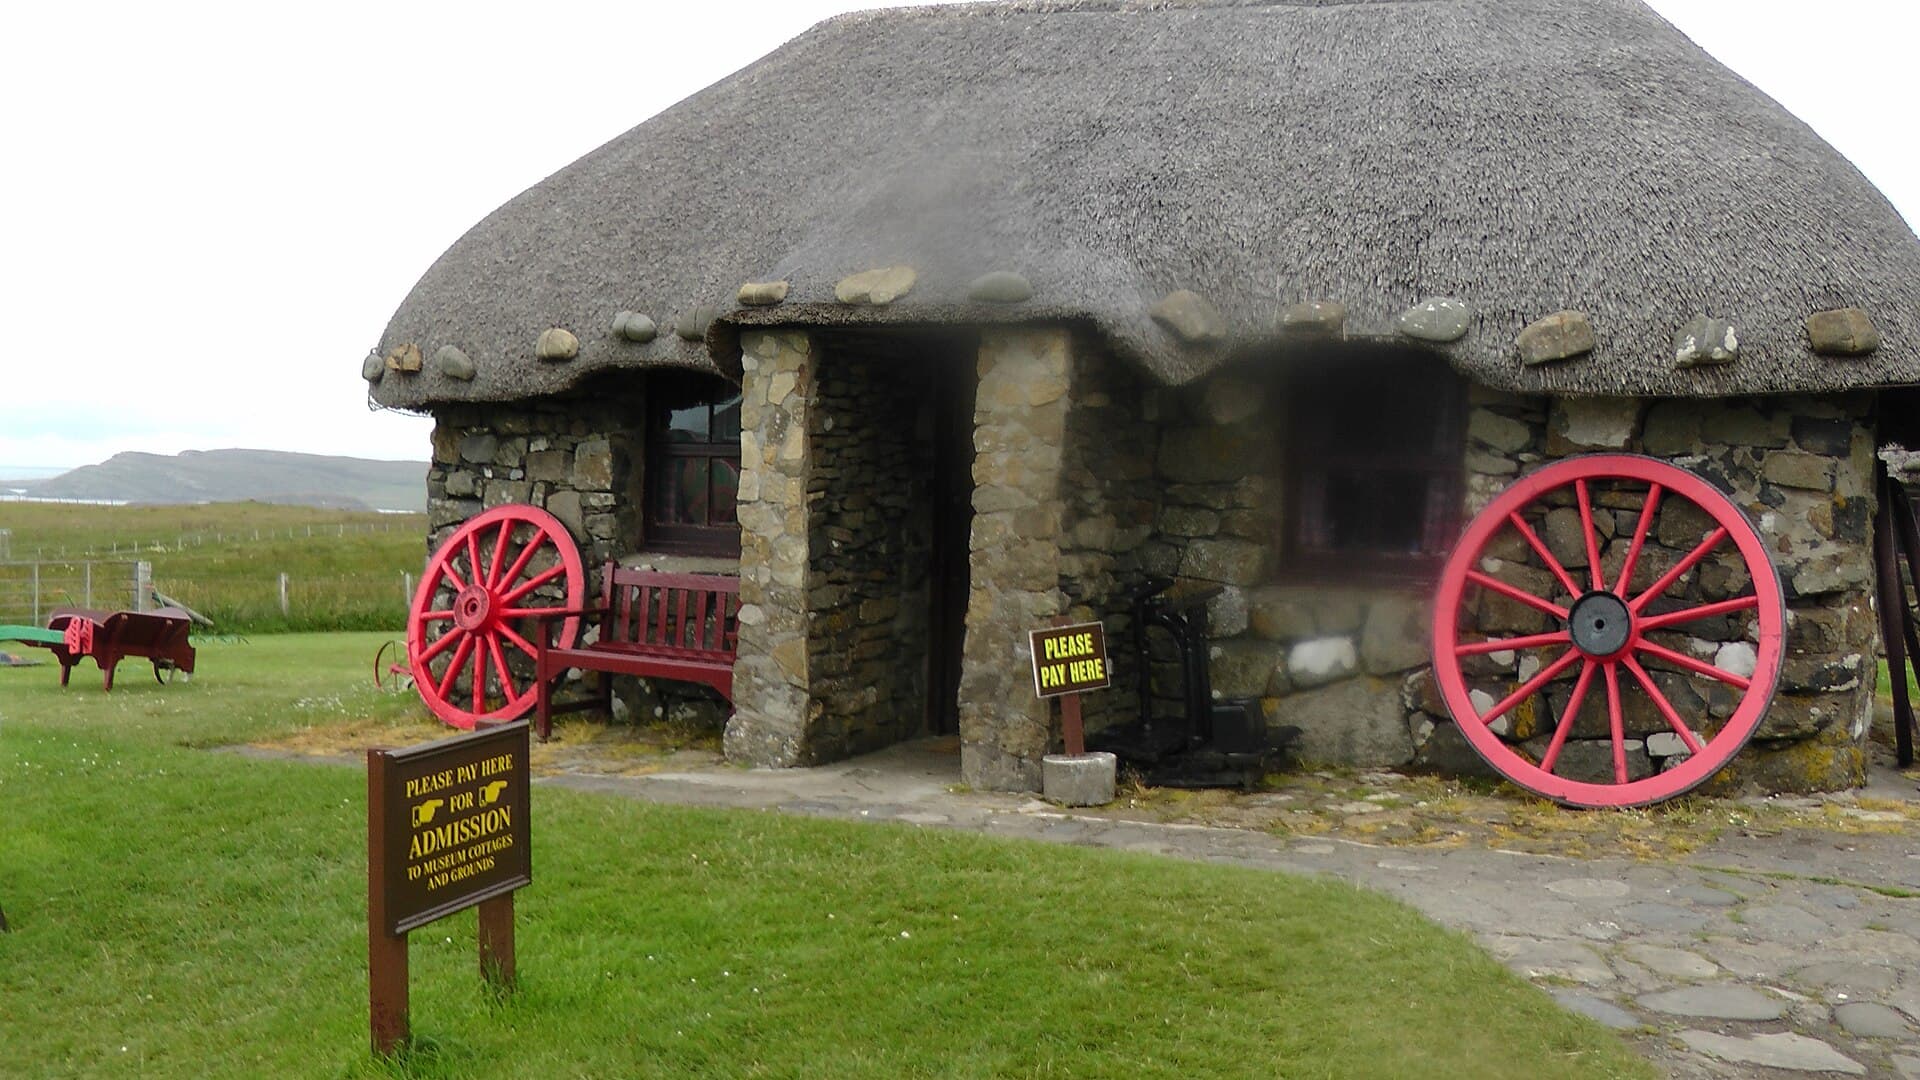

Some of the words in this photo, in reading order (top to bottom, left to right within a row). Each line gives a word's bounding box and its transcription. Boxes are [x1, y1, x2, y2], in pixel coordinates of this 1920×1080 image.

[1044, 632, 1094, 660] PLEASE
[1040, 664, 1066, 688] PAY
[1069, 658, 1105, 684] HERE
[406, 769, 453, 798] PLEASE
[457, 763, 478, 785] PAY
[481, 754, 513, 777] HERE
[450, 791, 474, 813] FOR
[409, 805, 511, 860] ADMISSION
[407, 865, 422, 881] TO
[423, 849, 467, 875] MUSEUM
[468, 833, 513, 857] COTTAGES
[427, 870, 449, 891] AND
[450, 856, 495, 883] GROUNDS
